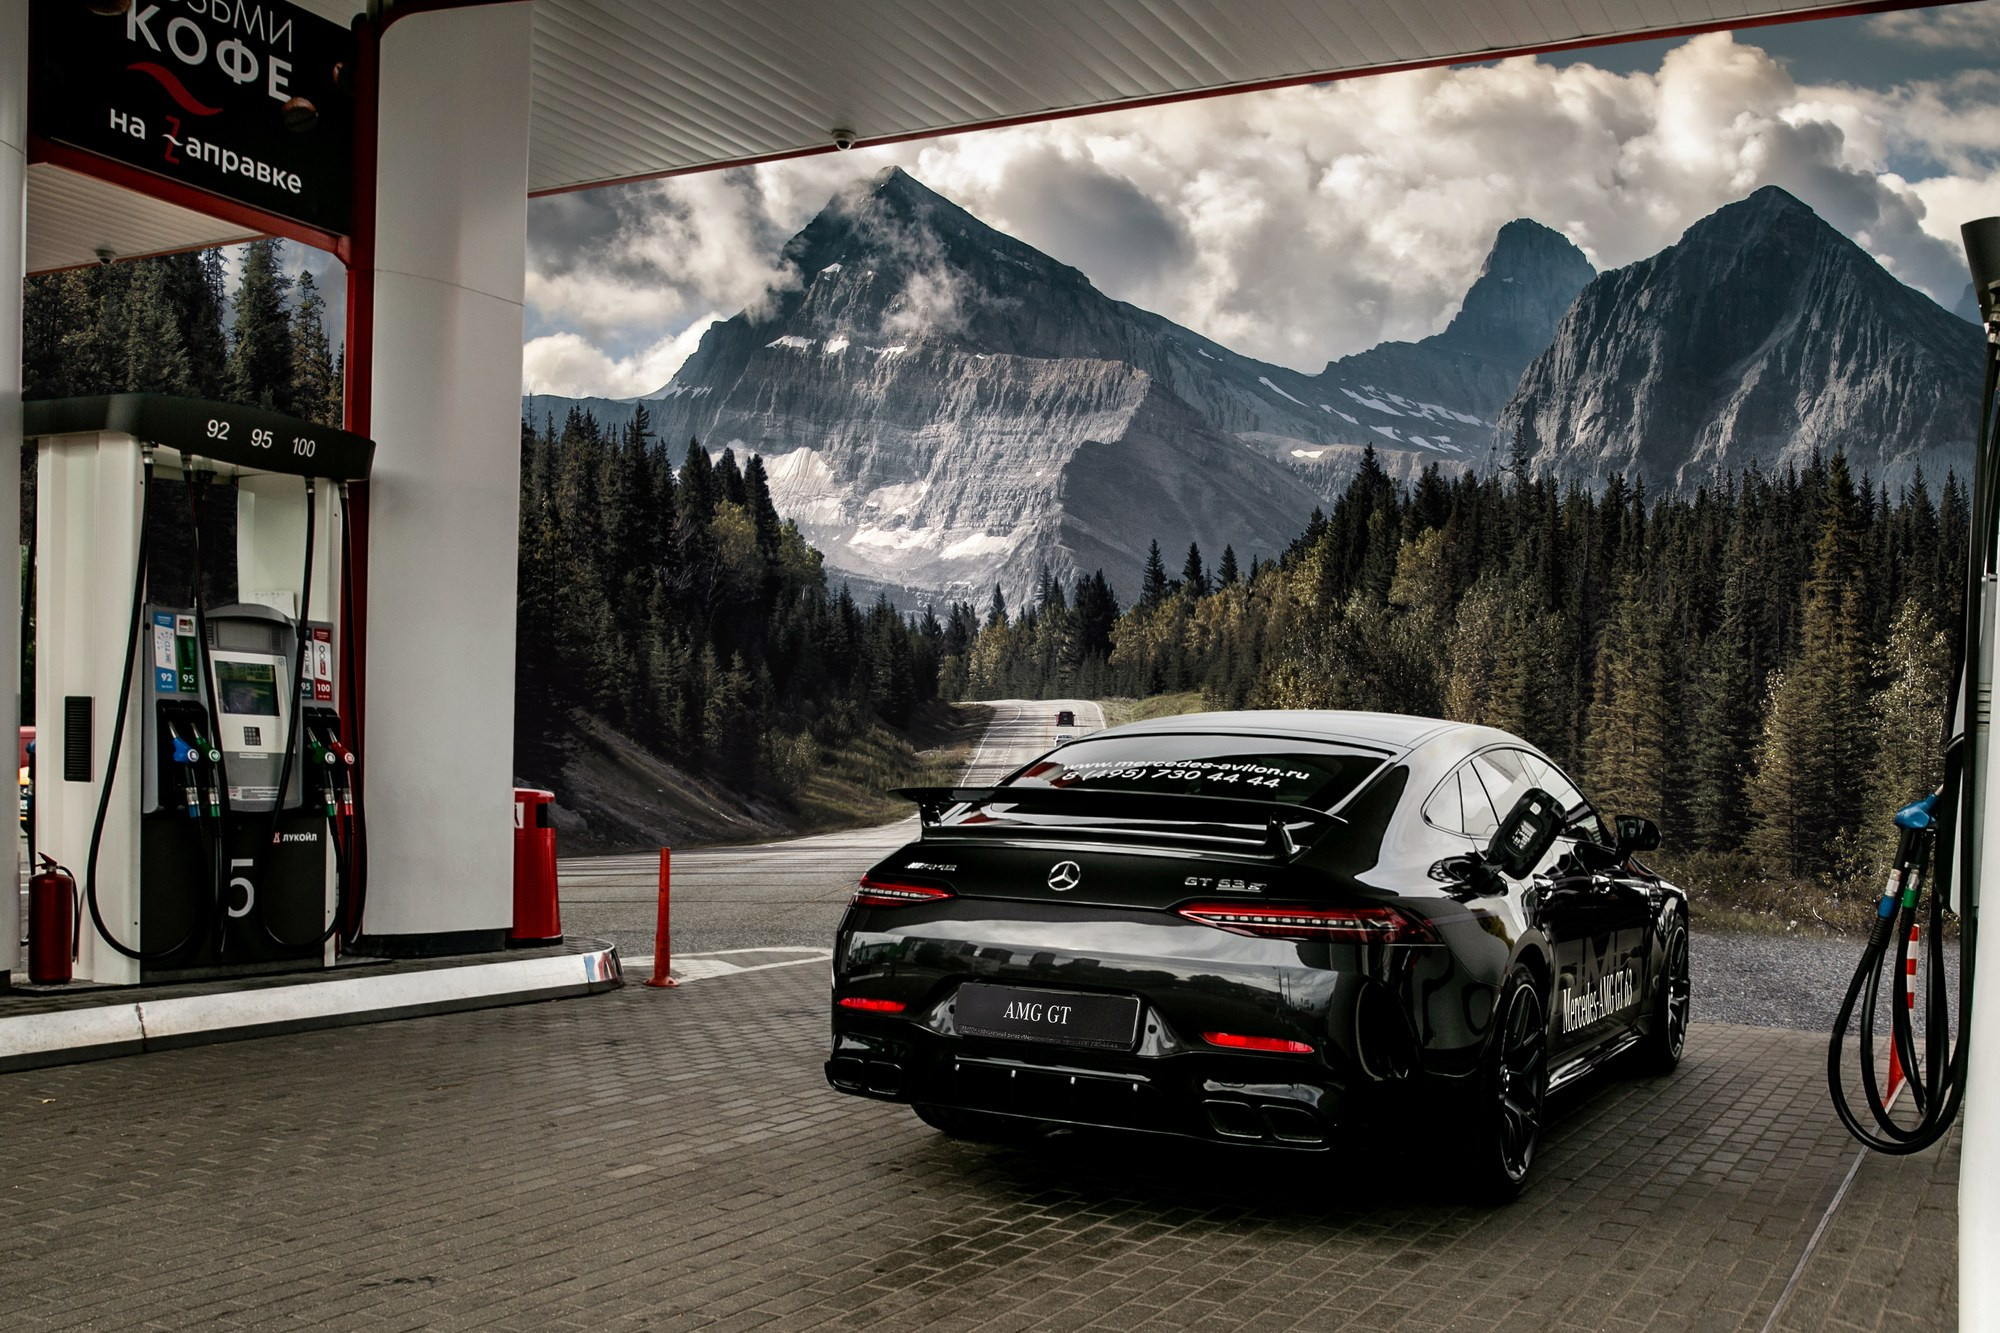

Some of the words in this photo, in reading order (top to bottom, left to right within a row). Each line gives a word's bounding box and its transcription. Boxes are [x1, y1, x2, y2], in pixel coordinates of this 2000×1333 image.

[127, 0, 293, 103] КОФЕ
[109, 108, 146, 140] на
[206, 419, 230, 440] 92
[250, 428, 274, 449] 95
[292, 437, 316, 457] 100
[161, 672, 173, 682] 92
[182, 674, 195, 683] 95
[301, 682, 311, 691] 95
[317, 683, 331, 693] 100
[1062, 771, 1078, 782] 8
[1082, 768, 1146, 782] (495)
[1151, 769, 1202, 781] 730
[1207, 773, 1239, 784] 44
[1247, 776, 1281, 789] 44
[1064, 760, 1310, 780] www.mercedes-avilon.ru
[282, 832, 318, 842] ЛУКОЙЛ
[227, 858, 255, 918] 5
[1184, 876, 1213, 887] GT
[1562, 974, 1614, 1034] Mercedes-AMG
[1614, 970, 1624, 1011] GT
[1624, 967, 1633, 1007] 63
[1003, 1001, 1043, 1022] AMG
[1046, 1004, 1072, 1025] GT
